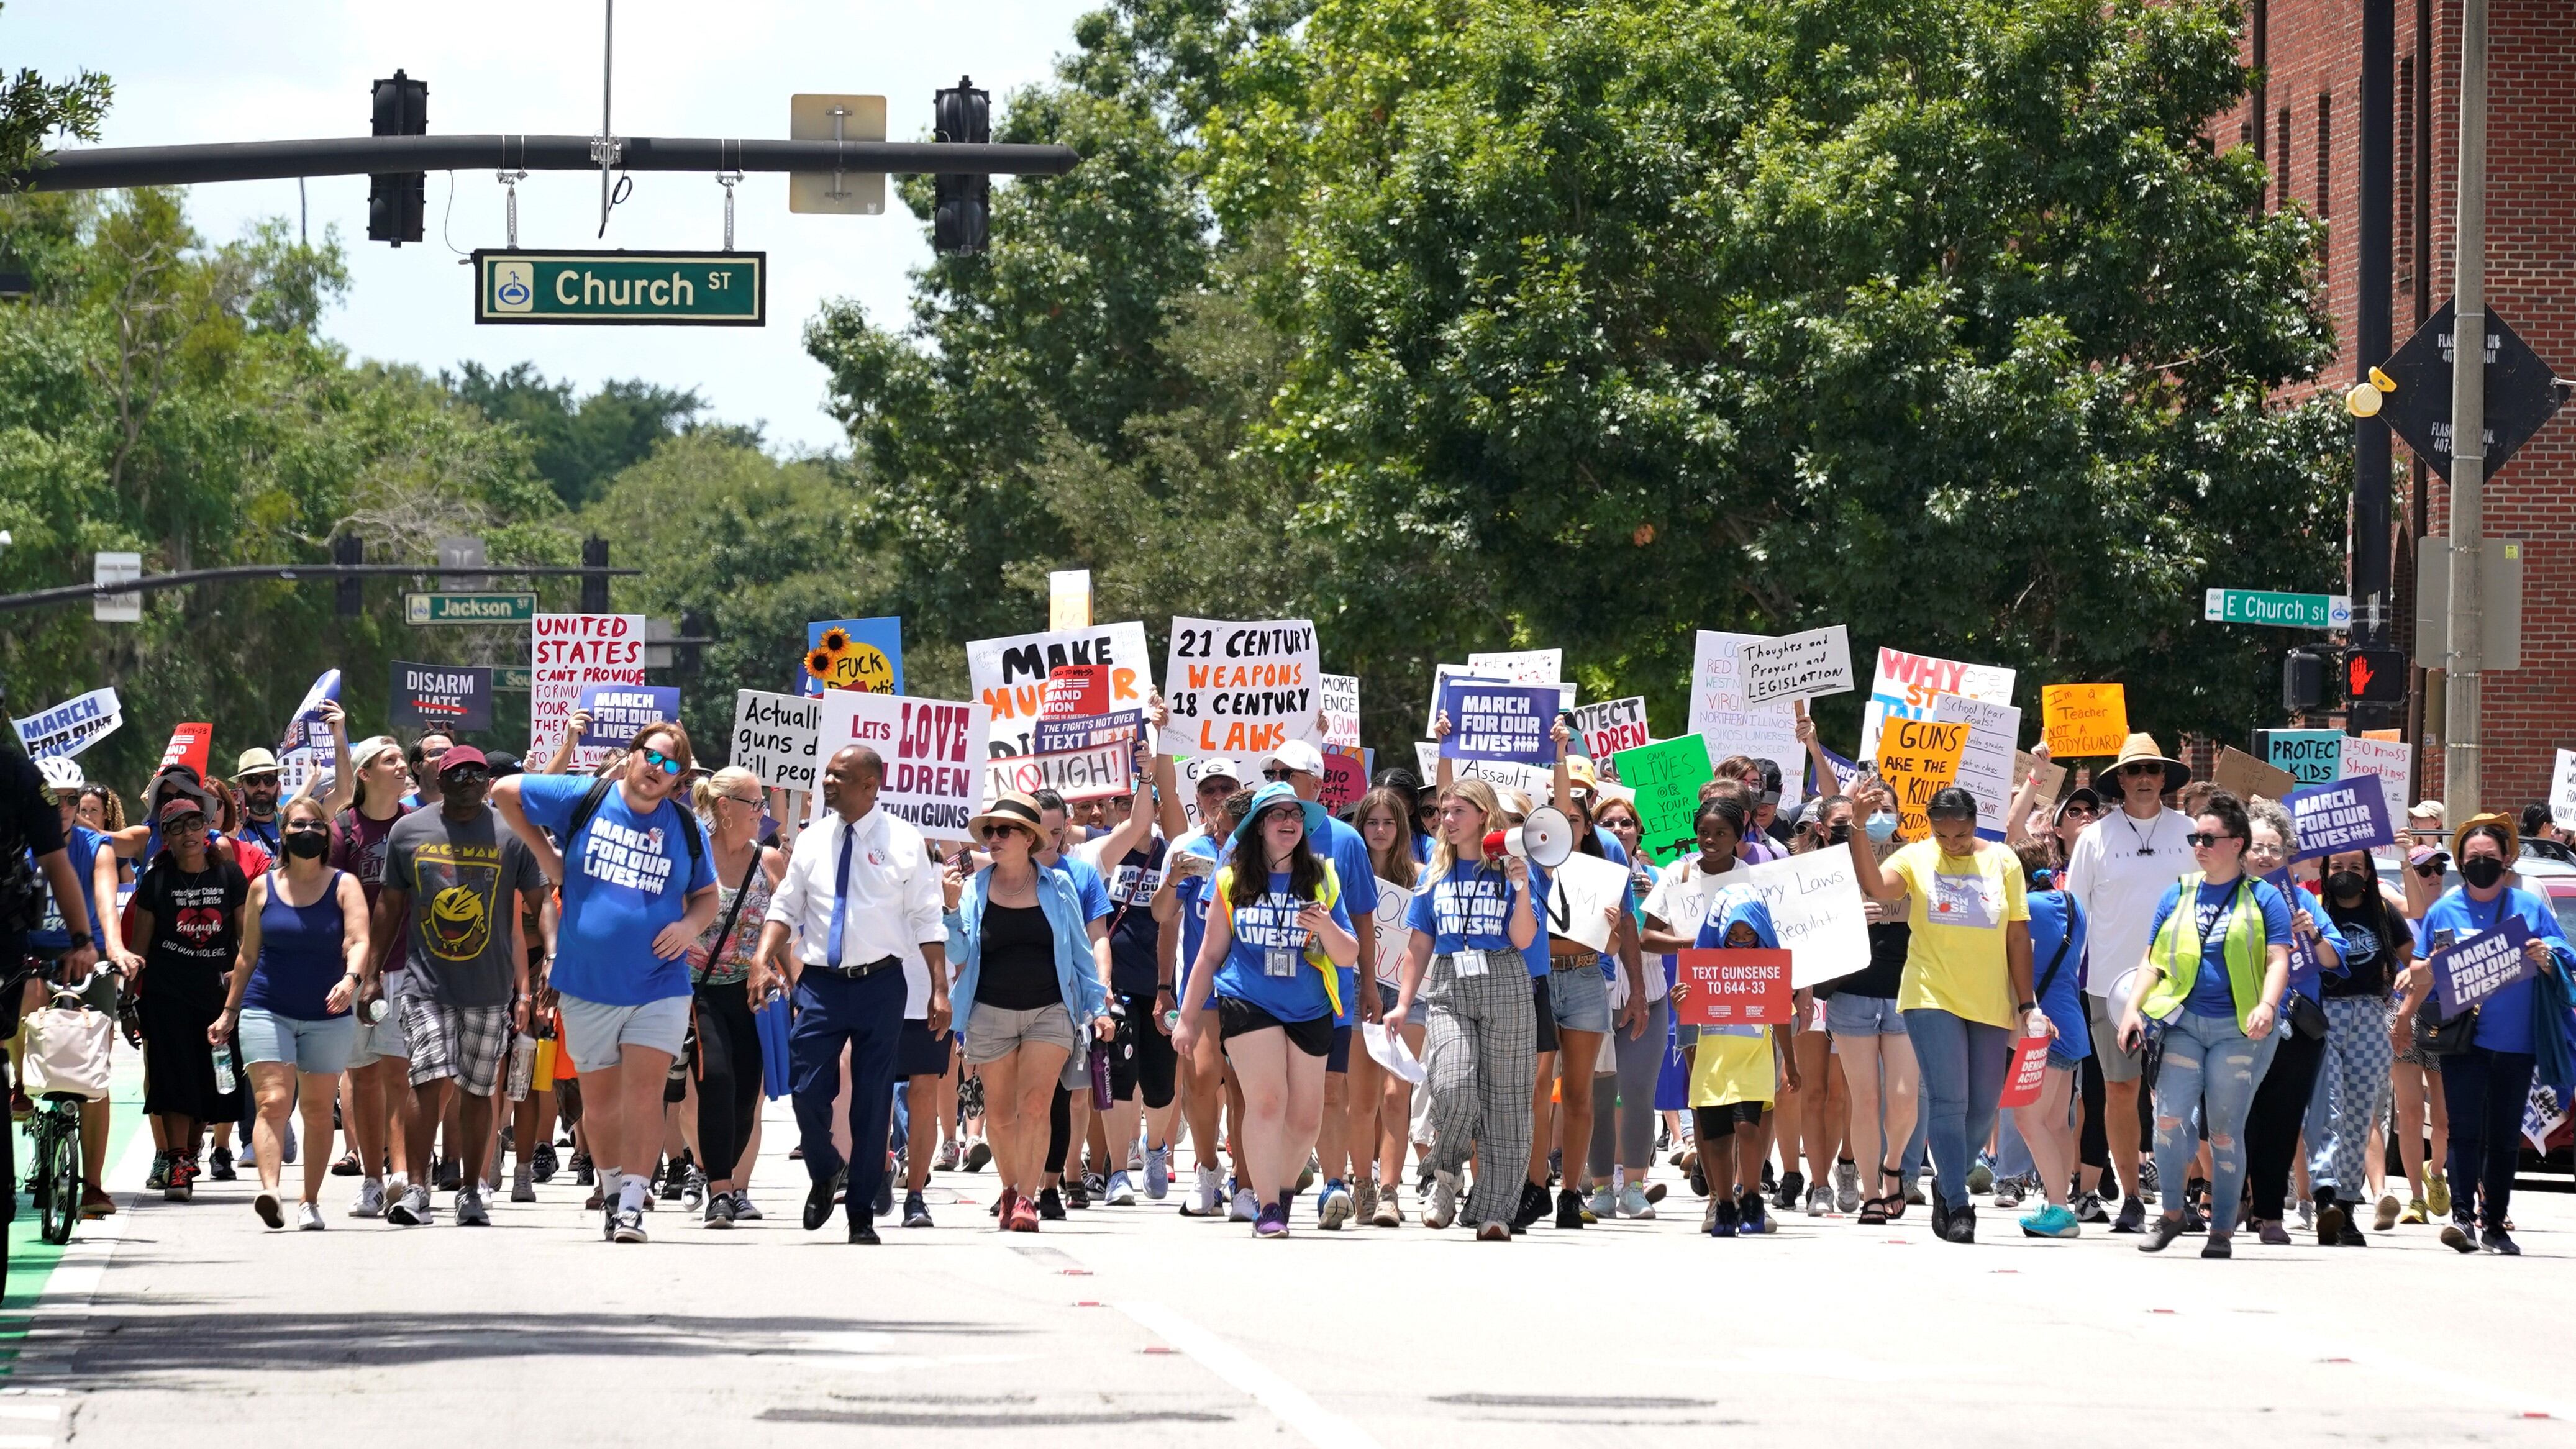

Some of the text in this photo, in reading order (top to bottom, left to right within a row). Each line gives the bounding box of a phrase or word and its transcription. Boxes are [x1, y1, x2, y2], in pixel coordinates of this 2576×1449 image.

[555, 269, 732, 306] Church ST
[439, 598, 512, 617] Jackson
[2226, 595, 2324, 621] E Church St
[537, 616, 627, 637] UNITED
[537, 640, 642, 665] STATES
[1226, 627, 1311, 658] CENTURY
[1744, 641, 1802, 661] Thoughts
[1809, 634, 1828, 648] and
[837, 653, 883, 678] FUCK
[1002, 636, 1113, 684] MAKE
[1706, 659, 1732, 675] RED
[1806, 651, 1826, 665] and
[583, 667, 645, 686] PROVIDE
[1188, 663, 1302, 689] WEAPONS
[1880, 647, 1969, 694] WHY
[407, 670, 473, 694] DISARM
[1748, 668, 1844, 699] LEGISLATION
[418, 694, 462, 715] HATE
[594, 693, 654, 707] MARCH
[1213, 688, 1310, 715] CENTURY
[2088, 689, 2096, 699] a
[535, 701, 570, 715] YOUR
[594, 707, 662, 723] FOR OUR
[744, 697, 821, 731] Actuall
[1462, 696, 1530, 714] MARCH
[1574, 699, 1639, 732] OTECT
[1943, 697, 2005, 720] School Year
[2057, 706, 2108, 720] Teacher
[22, 697, 101, 739] MARCH
[534, 719, 568, 734] THEY
[1044, 712, 1135, 733] THE FIGHT'S NOT OVER
[1333, 715, 1357, 735] GUN
[1461, 715, 1540, 734] FOR OUR
[1964, 714, 1994, 728] Goals:
[533, 734, 544, 747] A
[593, 723, 639, 738] LIVES
[851, 715, 891, 740] LETS
[898, 702, 970, 762] LOVE
[1042, 732, 1086, 751] TEXT
[1090, 725, 1137, 746] NEXT
[1200, 720, 1285, 752] LAWS
[1585, 722, 1646, 759] LDREN
[1708, 728, 1742, 742] OIKOS
[1900, 722, 1962, 752] GUNS
[2048, 723, 2088, 737] NOT A
[739, 729, 793, 753] guns
[1459, 734, 1513, 752] LIVES
[1708, 742, 1732, 750] ANDY
[1739, 743, 1763, 753] HOOK
[2343, 738, 2407, 762] 250 mass
[533, 752, 547, 763] TO
[1647, 752, 1666, 761] OUR
[1885, 755, 1914, 773] ARE
[1923, 759, 1947, 774] THE
[1461, 760, 1532, 789] Assault
[1632, 753, 1695, 787] LIVES
[2288, 763, 2332, 781] KIDS
[2346, 757, 2407, 781] Shootings
[880, 762, 970, 798] LDREN
[1657, 784, 1681, 798] OR
[1658, 797, 1690, 814] YOUR
[1979, 801, 1999, 814] SHOT
[2295, 788, 2356, 817] MARCH
[2554, 806, 2574, 820] ABOUT
[881, 802, 970, 829] THAN GUNS
[1901, 812, 1929, 830] KIDS
[2295, 805, 2372, 834] FOR OUR
[591, 817, 664, 855] MARCH
[2297, 826, 2351, 852] LIVES
[417, 843, 502, 860] PAC-MAN
[586, 837, 672, 877] FOR OUR
[584, 856, 639, 889] LIVES
[1681, 871, 1844, 920] 18th Laws
[1236, 907, 1273, 926] FOR
[1434, 897, 1508, 917] FOR OUR
[176, 919, 223, 935] Enough
[1437, 915, 1484, 936] LIVES
[1236, 926, 1288, 947] LIVES
[162, 940, 178, 951] END
[178, 945, 194, 956] GUN
[2447, 933, 2510, 973] MARCH
[1692, 966, 1780, 979] TEXT GUNSENSE
[2451, 947, 2521, 989] FOR OUR
[1707, 981, 1765, 994] TO 644-33
[2454, 973, 2500, 1006] LIVES
[2025, 1047, 2048, 1061] MOMS
